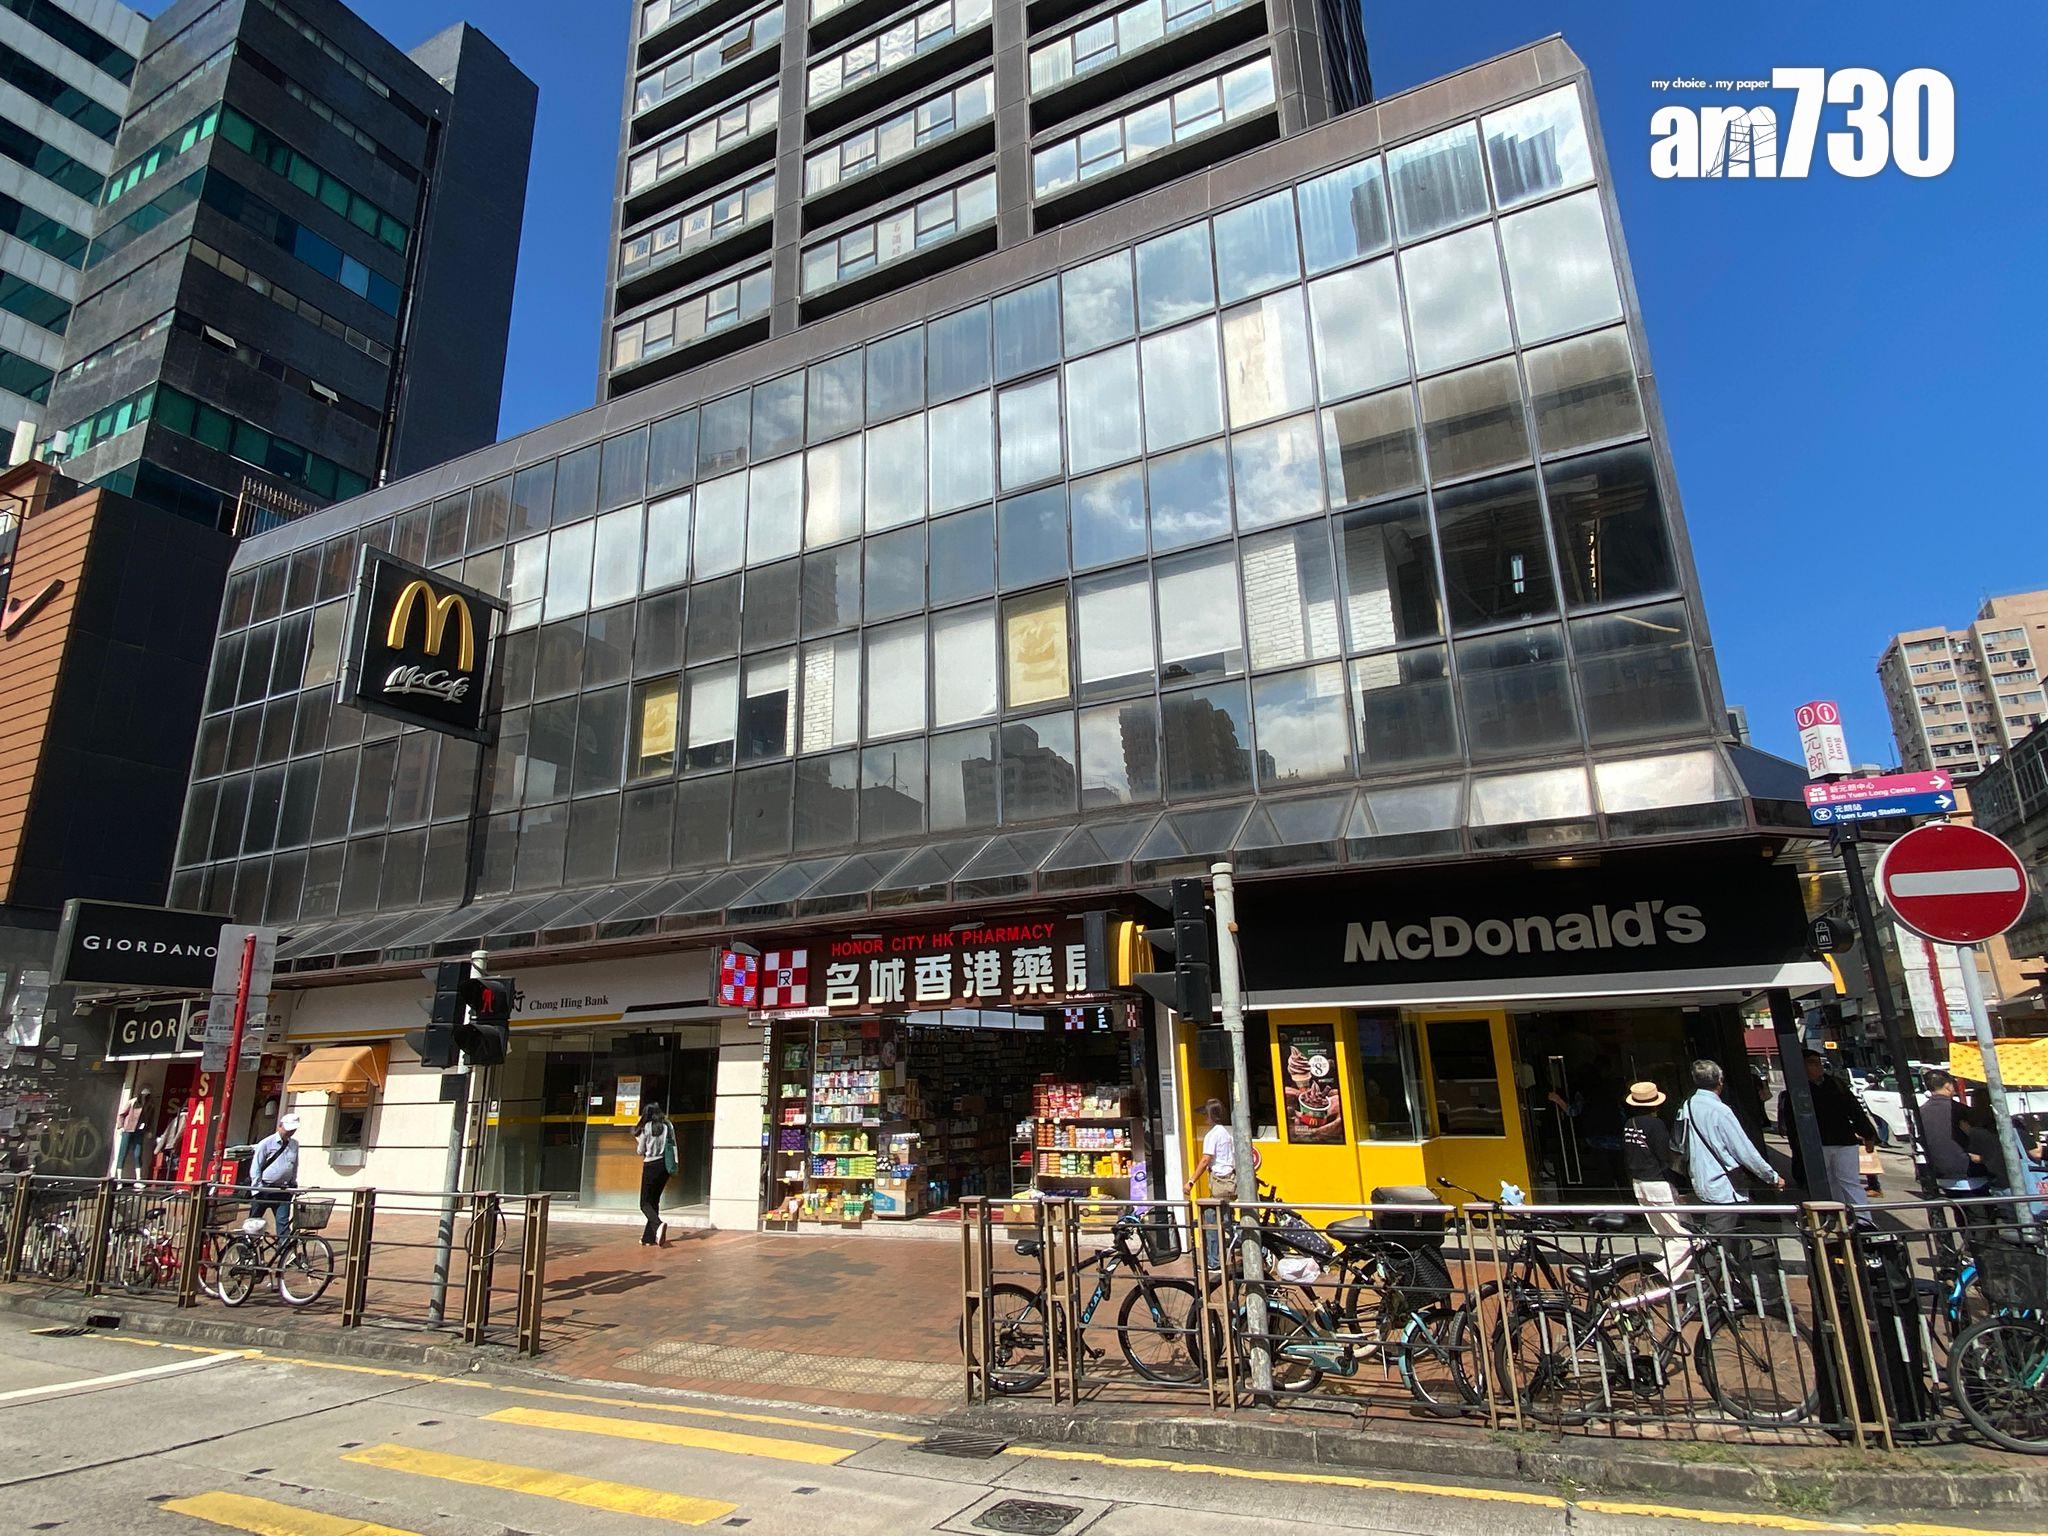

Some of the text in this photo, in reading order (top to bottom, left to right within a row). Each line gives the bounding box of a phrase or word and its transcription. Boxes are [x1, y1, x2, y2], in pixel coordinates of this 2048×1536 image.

[1804, 733, 1826, 772] 元朗
[1826, 736, 1835, 761] Yuen
[1834, 737, 1845, 760] Long
[1829, 782, 1875, 793] 新元朗中心
[1889, 787, 1917, 795] Centre
[1834, 803, 1863, 813] 元朗站
[1857, 810, 1878, 818] Long
[1878, 807, 1907, 816] Station
[831, 923, 1055, 957] HONOR CITY HK PHARMACY
[1343, 900, 1706, 963] McDonald's
[83, 935, 219, 958] GIORDANO
[529, 994, 609, 1011] Chong Hing Bank
[183, 1072, 210, 1183] SALE
